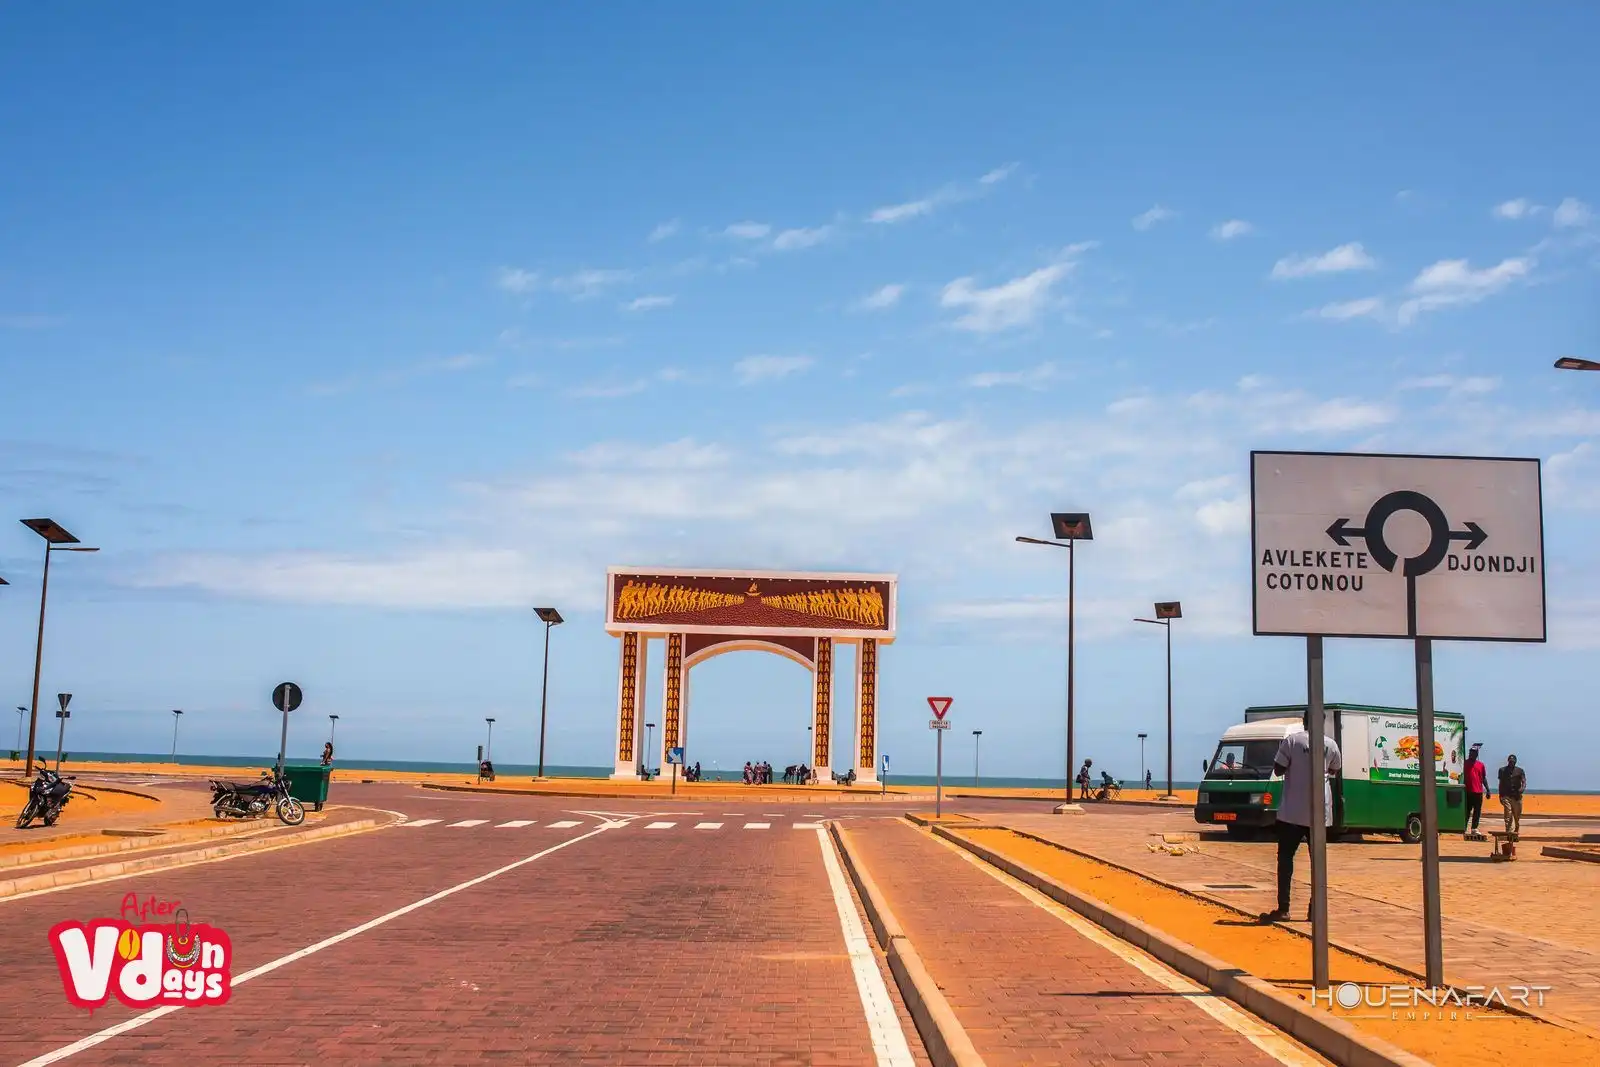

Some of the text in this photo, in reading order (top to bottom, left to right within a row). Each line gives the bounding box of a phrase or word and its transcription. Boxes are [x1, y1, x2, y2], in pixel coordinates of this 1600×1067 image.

[1262, 550, 1368, 569] AVLEKETE
[1448, 555, 1535, 573] DJONDJI
[1266, 573, 1364, 591] COTONOU
